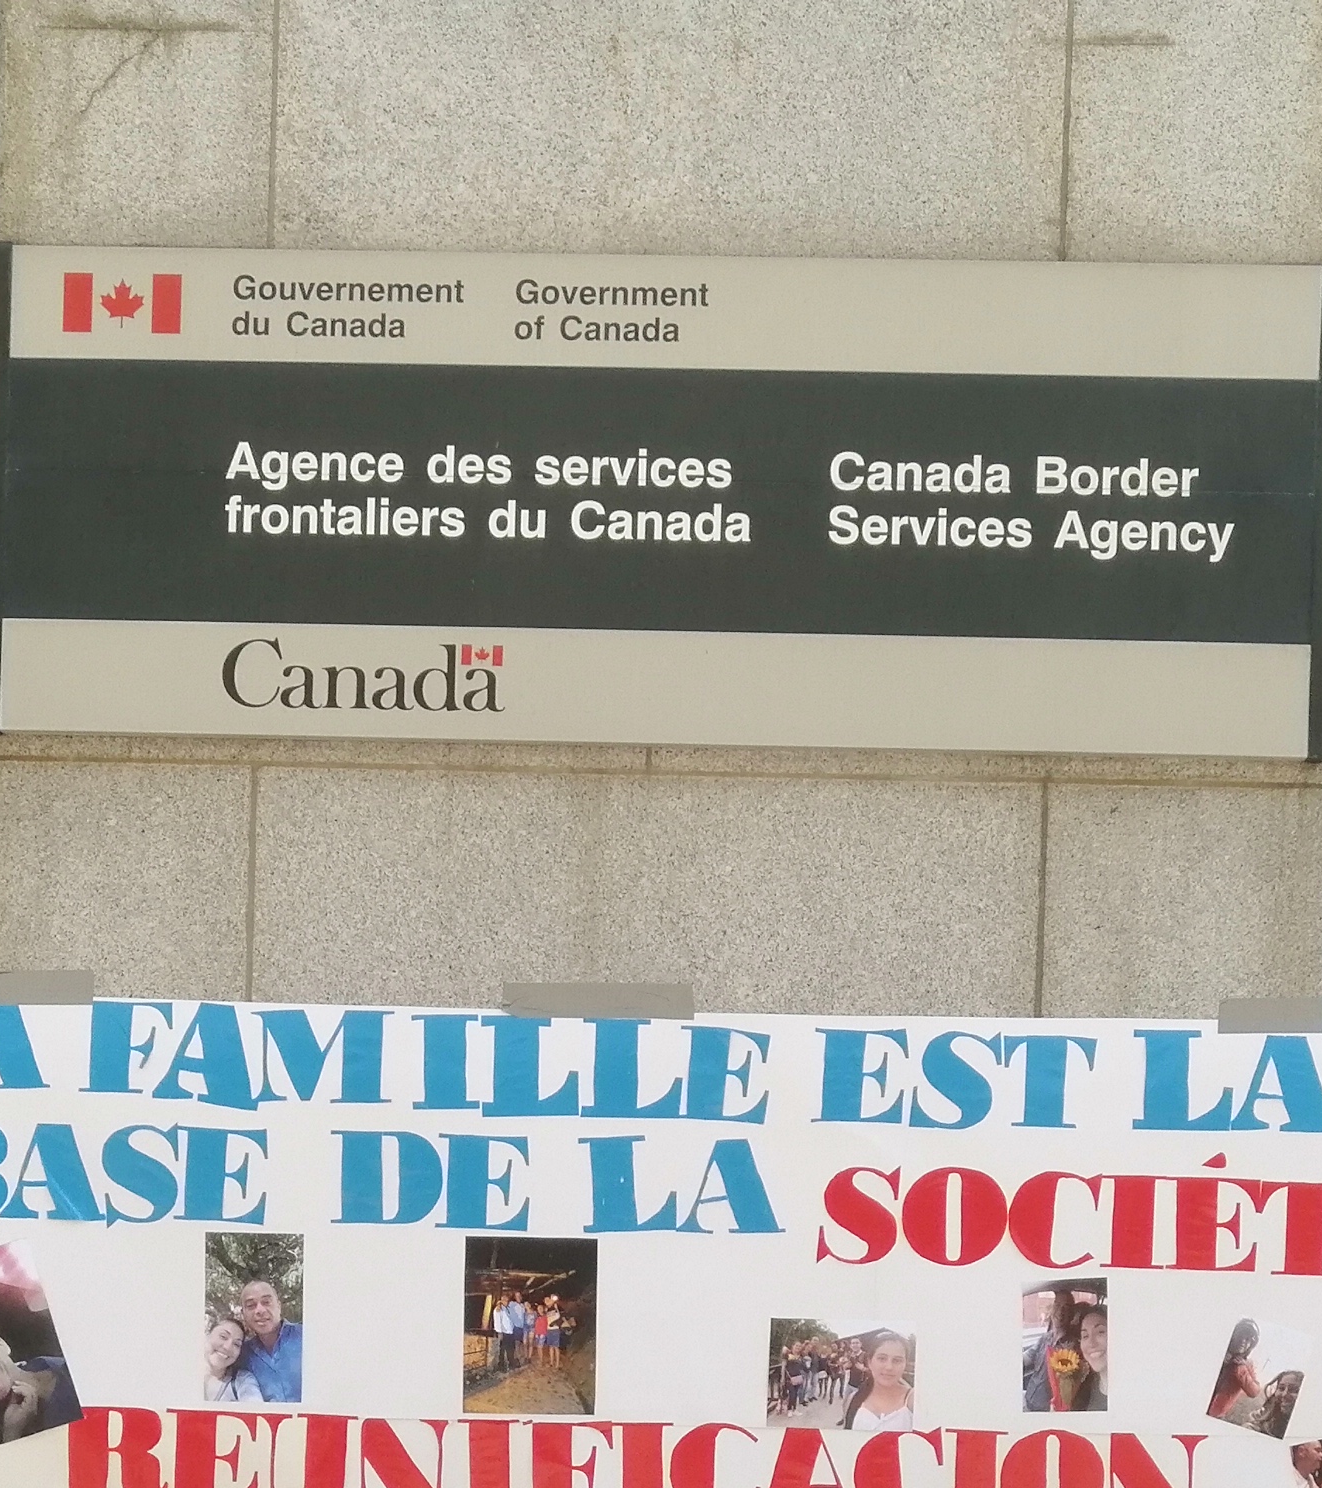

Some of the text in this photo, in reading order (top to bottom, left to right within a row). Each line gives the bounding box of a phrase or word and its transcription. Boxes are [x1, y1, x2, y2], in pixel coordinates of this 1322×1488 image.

[232, 273, 464, 305] Gouvernement
[515, 279, 709, 309] Government
[231, 309, 405, 340] du Canada
[514, 313, 679, 344] of Canada
[227, 442, 731, 491] Agence des services
[829, 450, 1197, 497] Canada Border
[224, 495, 751, 545] frontaliers du Canada
[828, 505, 1234, 561] Services Agency
[221, 638, 504, 714] Canada
[79, 1000, 770, 1125] FAMILLE
[813, 1028, 1097, 1130] EST
[330, 1131, 529, 1232] DE
[578, 1134, 786, 1235] LA
